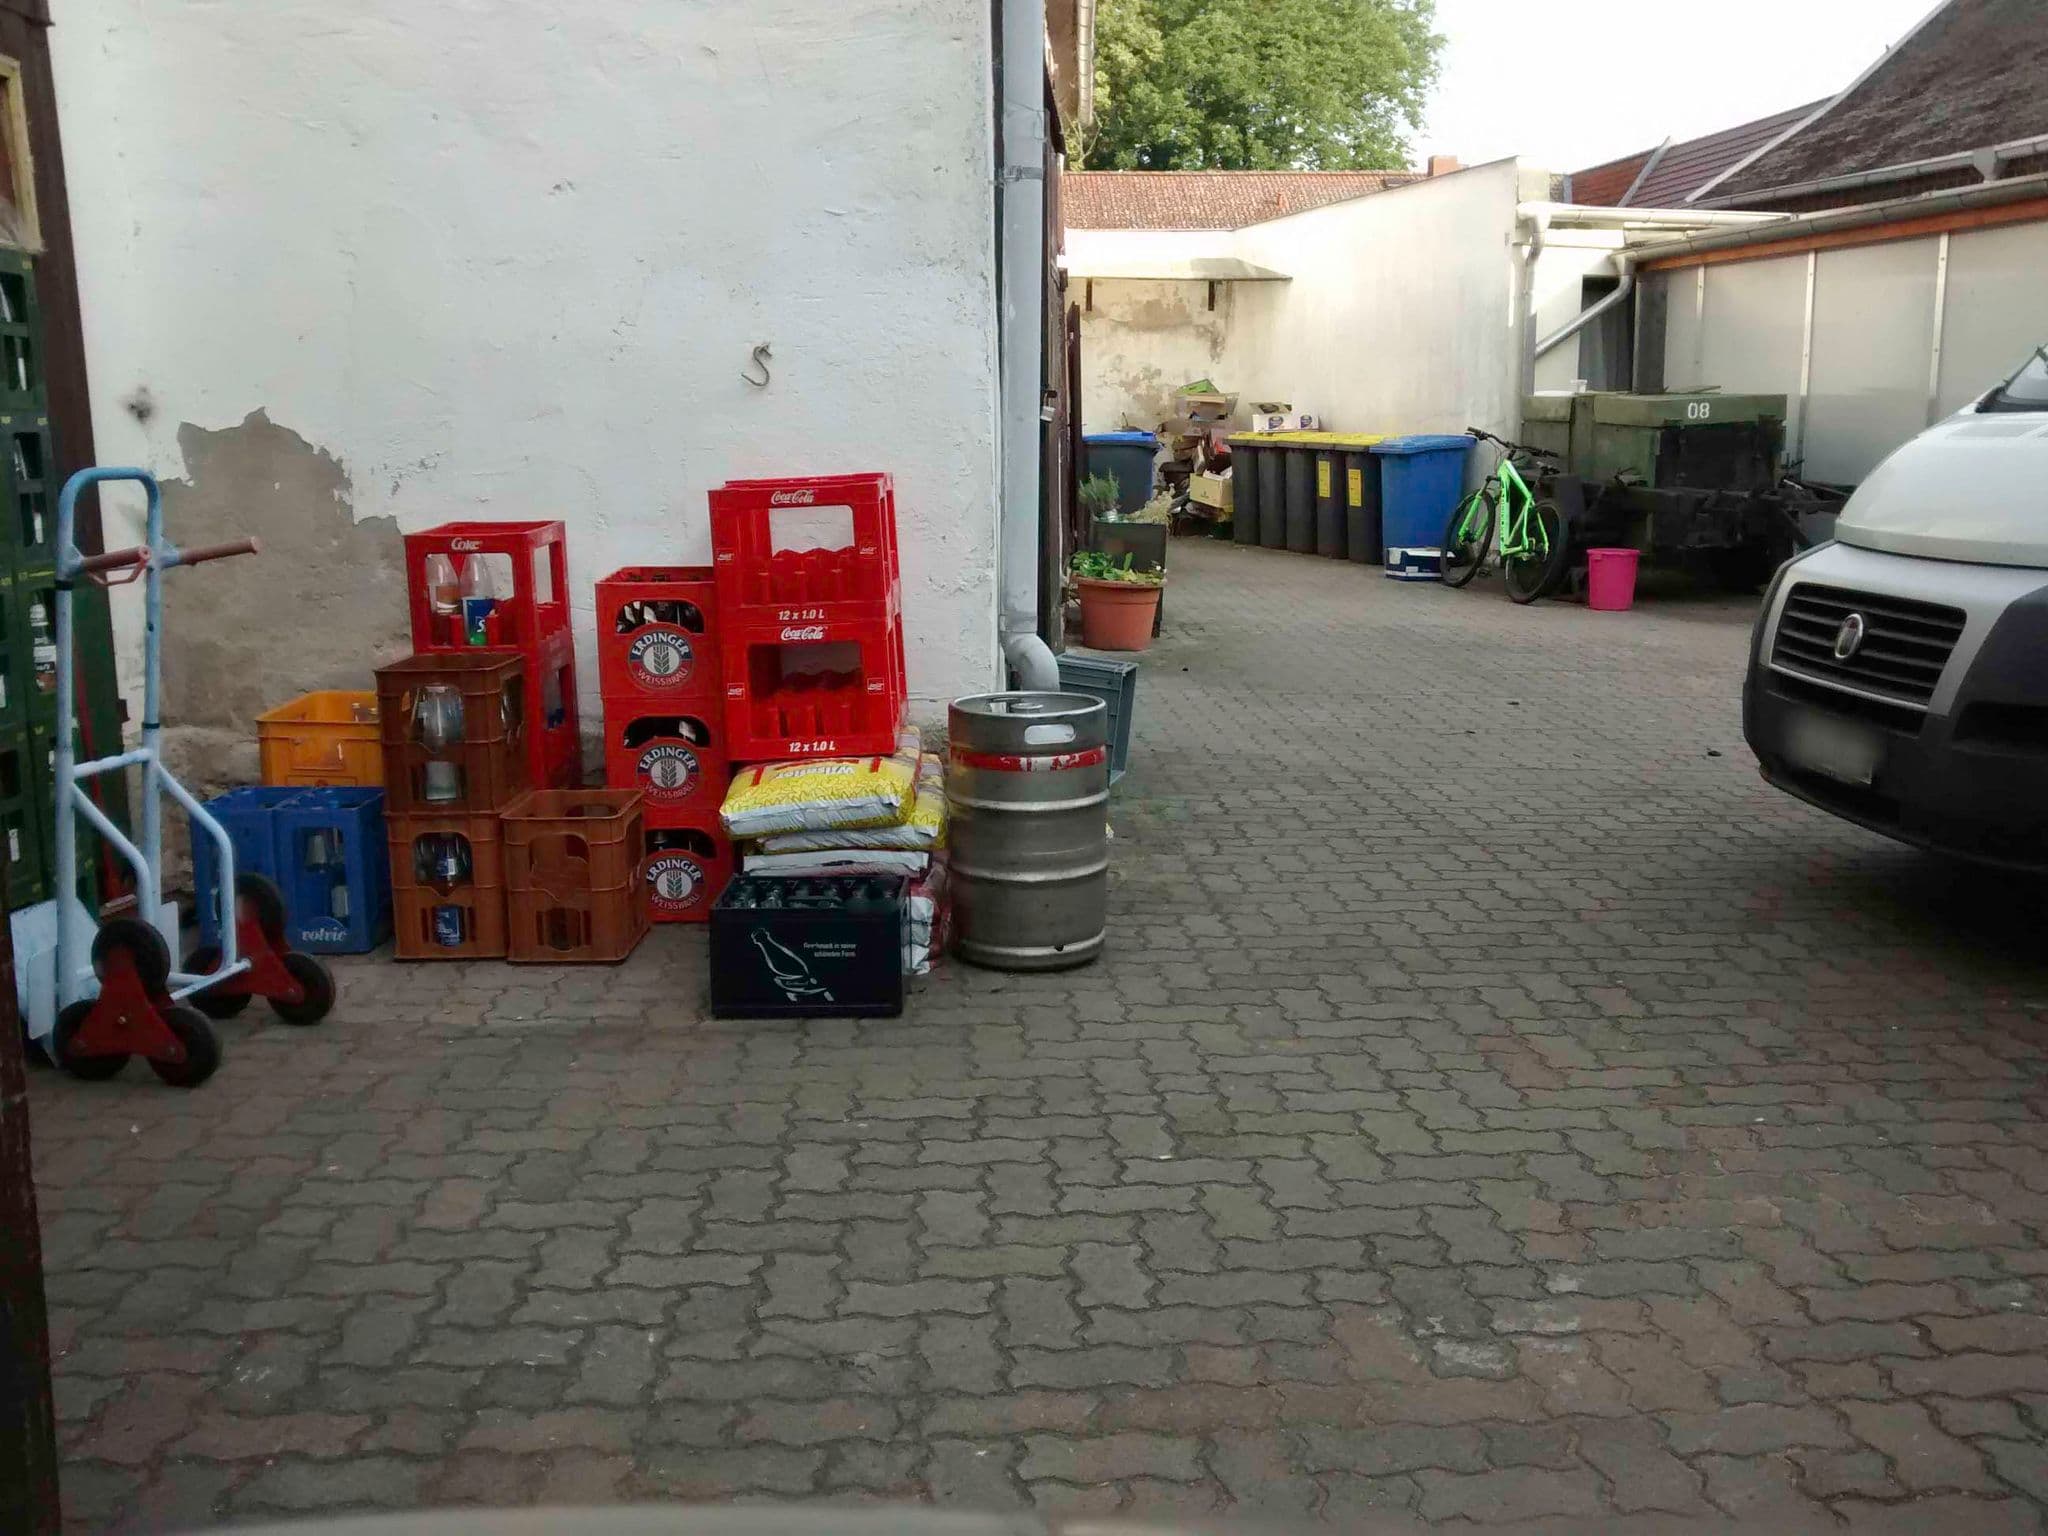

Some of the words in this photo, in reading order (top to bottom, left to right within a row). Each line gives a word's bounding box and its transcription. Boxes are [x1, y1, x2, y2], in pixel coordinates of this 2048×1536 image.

[1688, 402, 1710, 420] 08
[771, 489, 815, 505] Coca-Cola
[778, 610, 790, 621] 12
[818, 608, 825, 619] L
[781, 626, 825, 641] Coca-Cola
[631, 632, 690, 656] ERDINGER
[789, 742, 801, 753] 12
[828, 740, 836, 751] L
[639, 746, 698, 770] ERDINGER
[646, 858, 702, 883] ERDINGER
